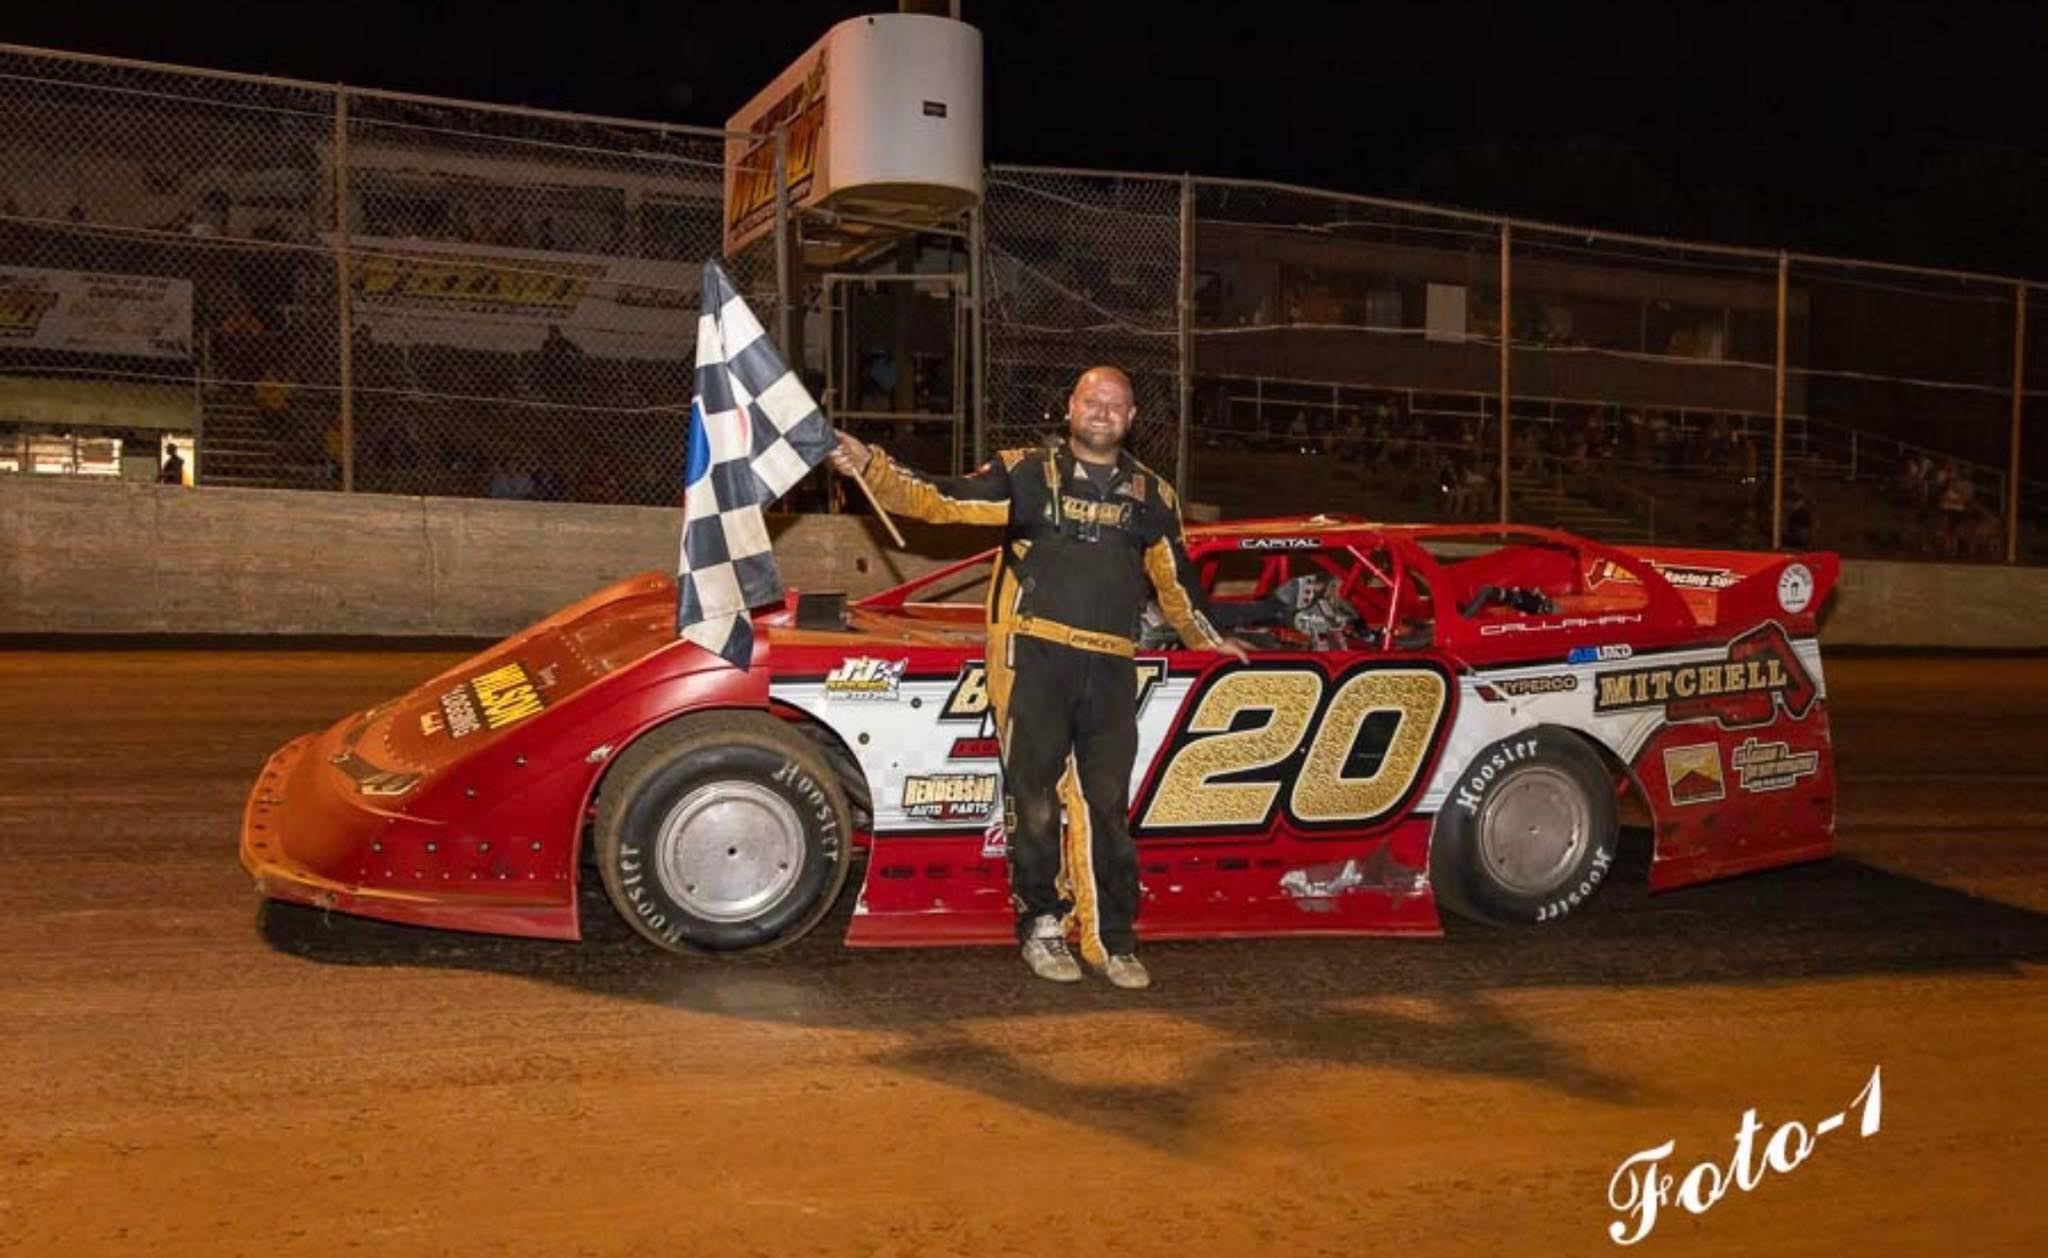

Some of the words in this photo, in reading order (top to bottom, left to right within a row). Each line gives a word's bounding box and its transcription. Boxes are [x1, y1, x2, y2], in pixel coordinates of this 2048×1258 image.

[1242, 538, 1321, 549] CAPITAL
[1664, 571, 1708, 586] Racing
[1481, 614, 1641, 635] CALLAHAN
[470, 661, 545, 730] WILSON
[1600, 660, 1787, 706] MITCHELL
[1140, 668, 1447, 828] 20
[1455, 737, 1539, 815] Hoosier
[772, 760, 840, 862] Hoosier
[904, 777, 995, 806] HENDERSON
[912, 804, 943, 816] AUTO
[949, 802, 989, 815] PARTS
[620, 844, 682, 945] Hoosier
[1535, 847, 1613, 923] Hoosier
